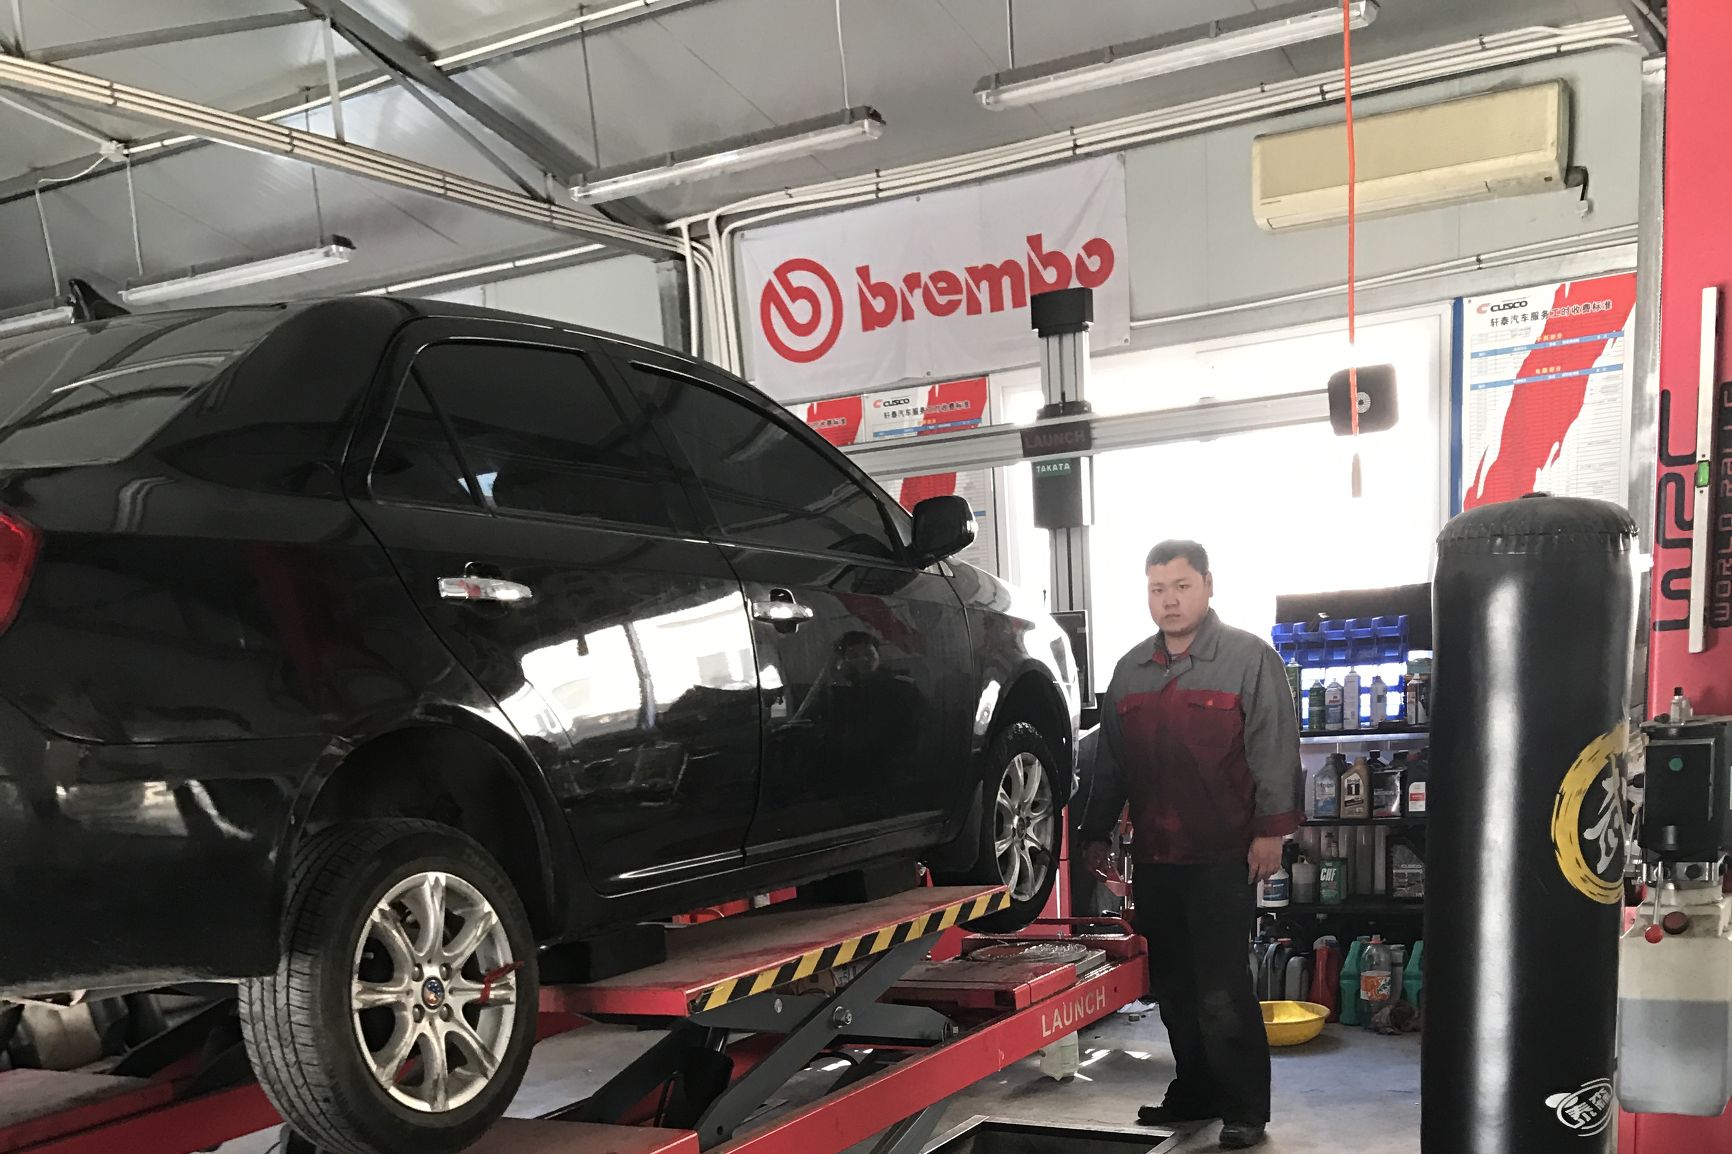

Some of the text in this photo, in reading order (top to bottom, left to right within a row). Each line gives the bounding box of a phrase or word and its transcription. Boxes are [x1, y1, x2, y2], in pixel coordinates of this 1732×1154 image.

[856, 233, 1115, 332] brembo
[1490, 300, 1528, 312] CUSCO
[1490, 300, 1612, 327] 轩泰汽车服务工时收费标准
[883, 398, 910, 408] CUSCO
[1025, 430, 1085, 448] LAUNCH
[1036, 463, 1070, 473] TAKATA
[1041, 985, 1106, 1037] LAUNCH
